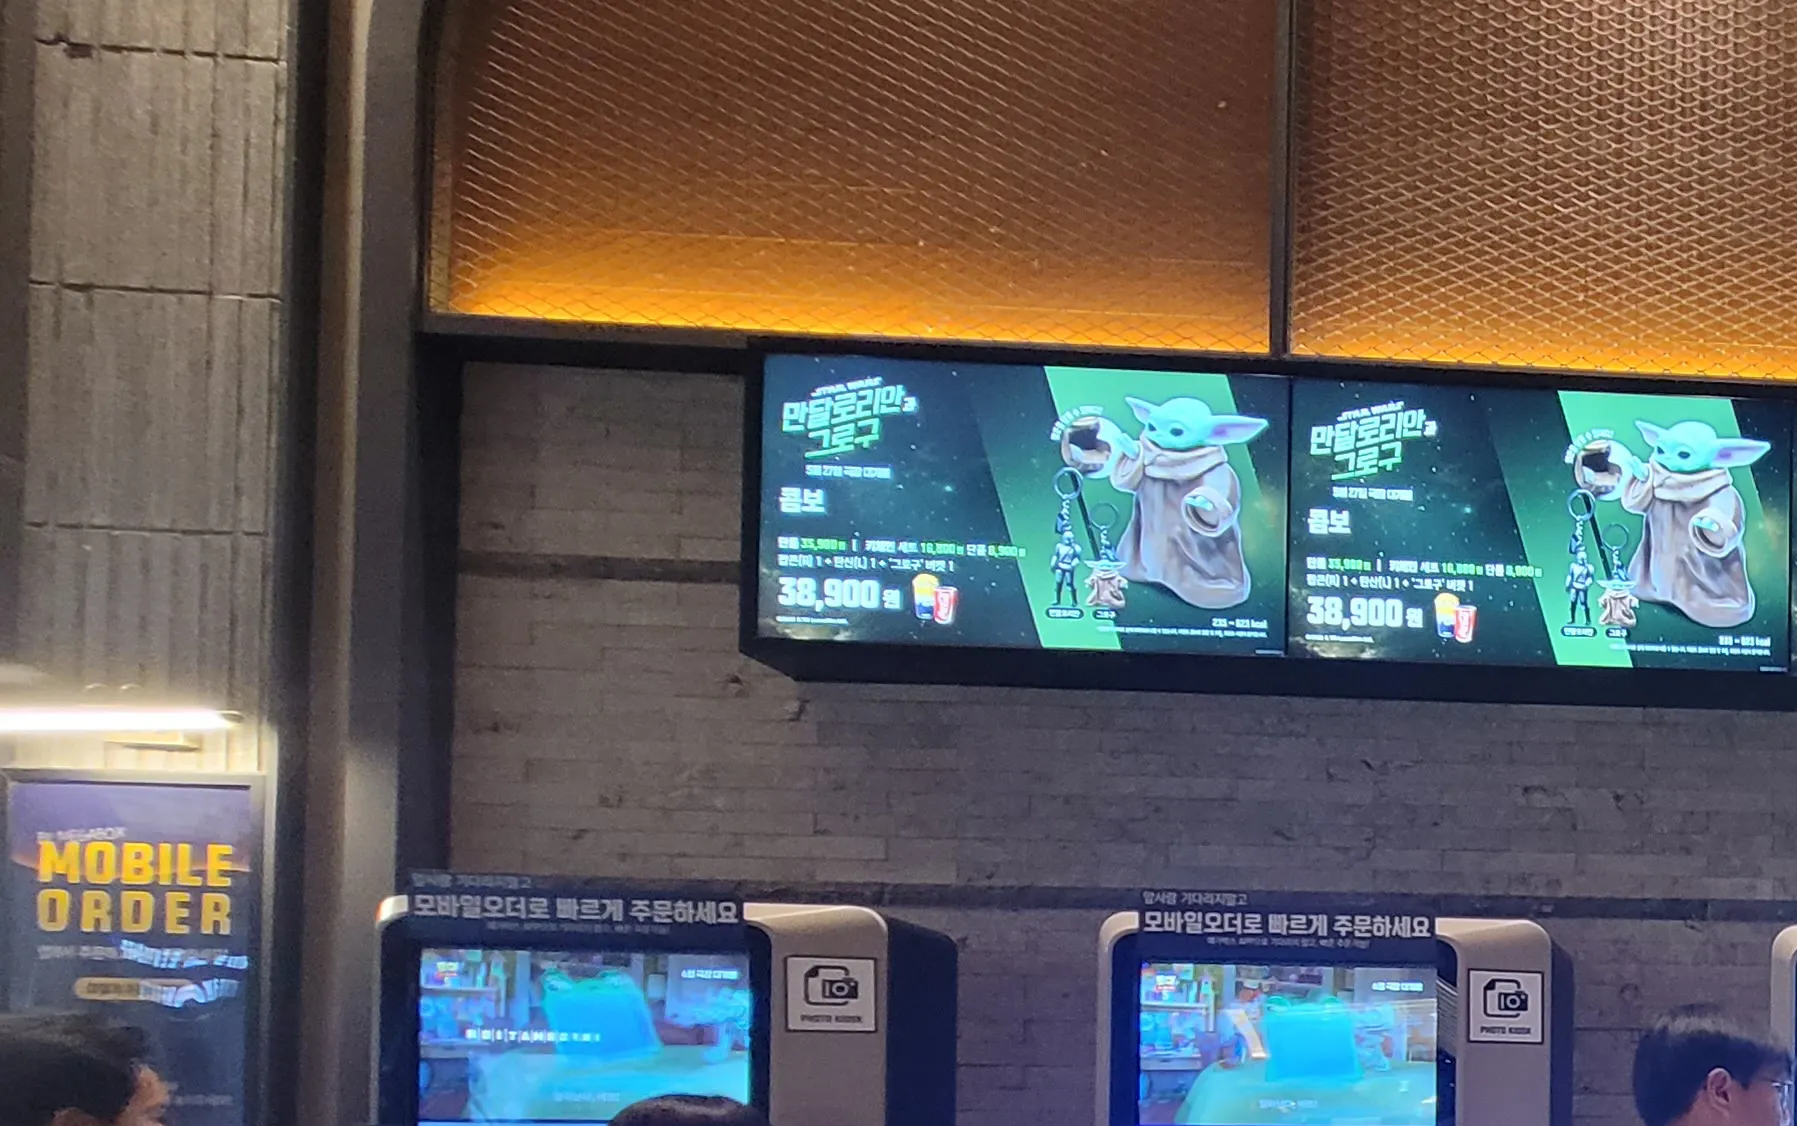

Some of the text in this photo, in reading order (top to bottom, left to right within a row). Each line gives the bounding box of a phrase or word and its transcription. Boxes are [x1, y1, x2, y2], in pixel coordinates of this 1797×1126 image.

[804, 417, 881, 459] 그로구
[1331, 441, 1403, 480] 그로구
[778, 487, 825, 513] 콤보
[1307, 508, 1351, 534] 콤보
[777, 577, 880, 612] 38,900
[1306, 596, 1403, 631] 38,900
[37, 841, 233, 887] MOBILE
[37, 888, 232, 935] ORDER
[414, 894, 739, 924] 모바일오더로 빠르게 주문하세요
[1143, 891, 1177, 905] 앞사람
[1143, 911, 1431, 938] 모바일오더로 빠르게 주문하세요
[801, 1014, 832, 1023] PHOTO
[1480, 1026, 1506, 1034] PHOTO
